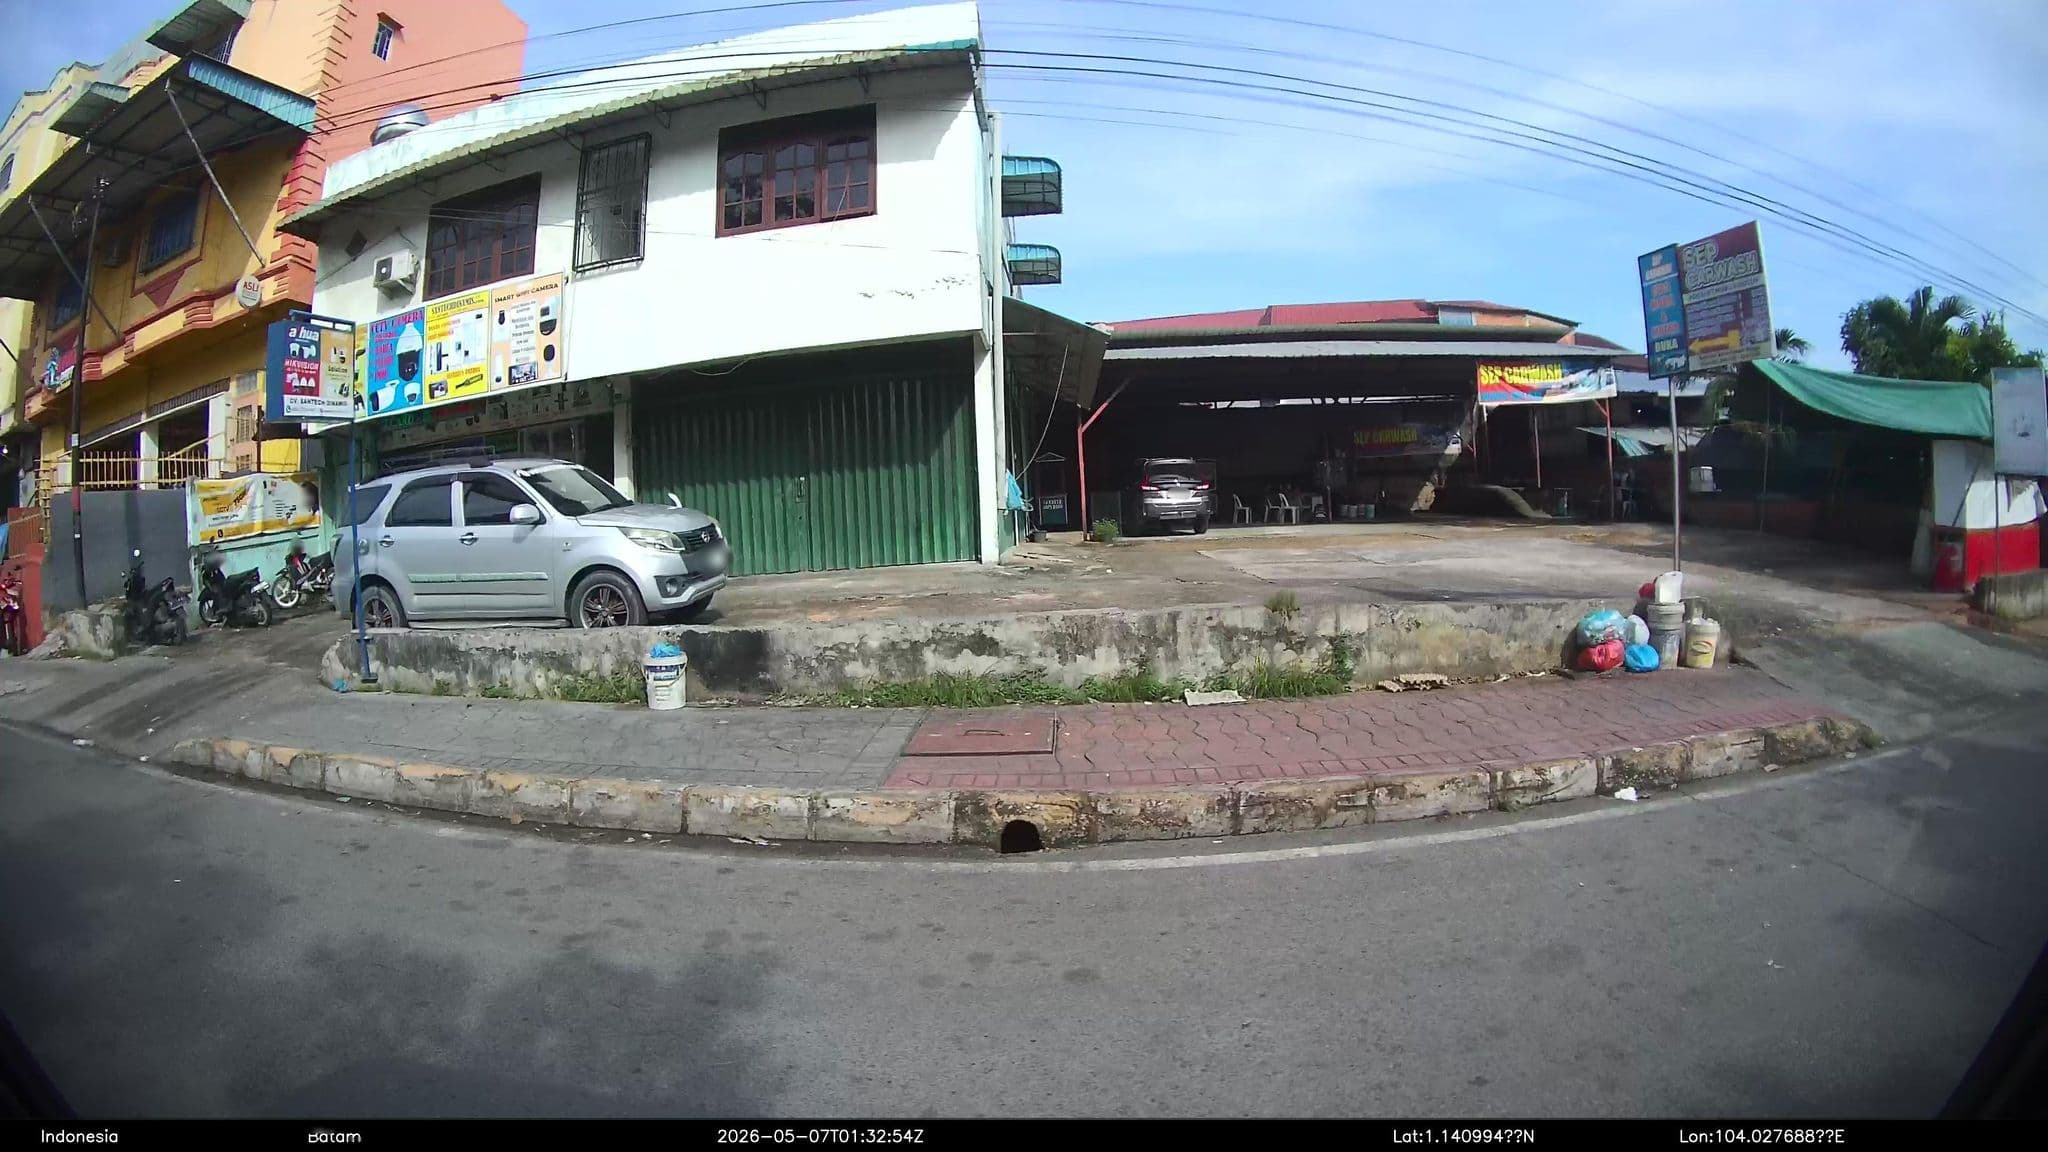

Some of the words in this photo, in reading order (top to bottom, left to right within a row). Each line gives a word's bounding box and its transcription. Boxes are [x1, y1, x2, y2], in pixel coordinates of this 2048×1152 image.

[1684, 242, 1717, 268] SEP
[1686, 251, 1758, 289] CARWASH
[495, 294, 514, 303] SMART
[531, 283, 559, 294] CAMERA
[1503, 363, 1562, 384] CARWASH
